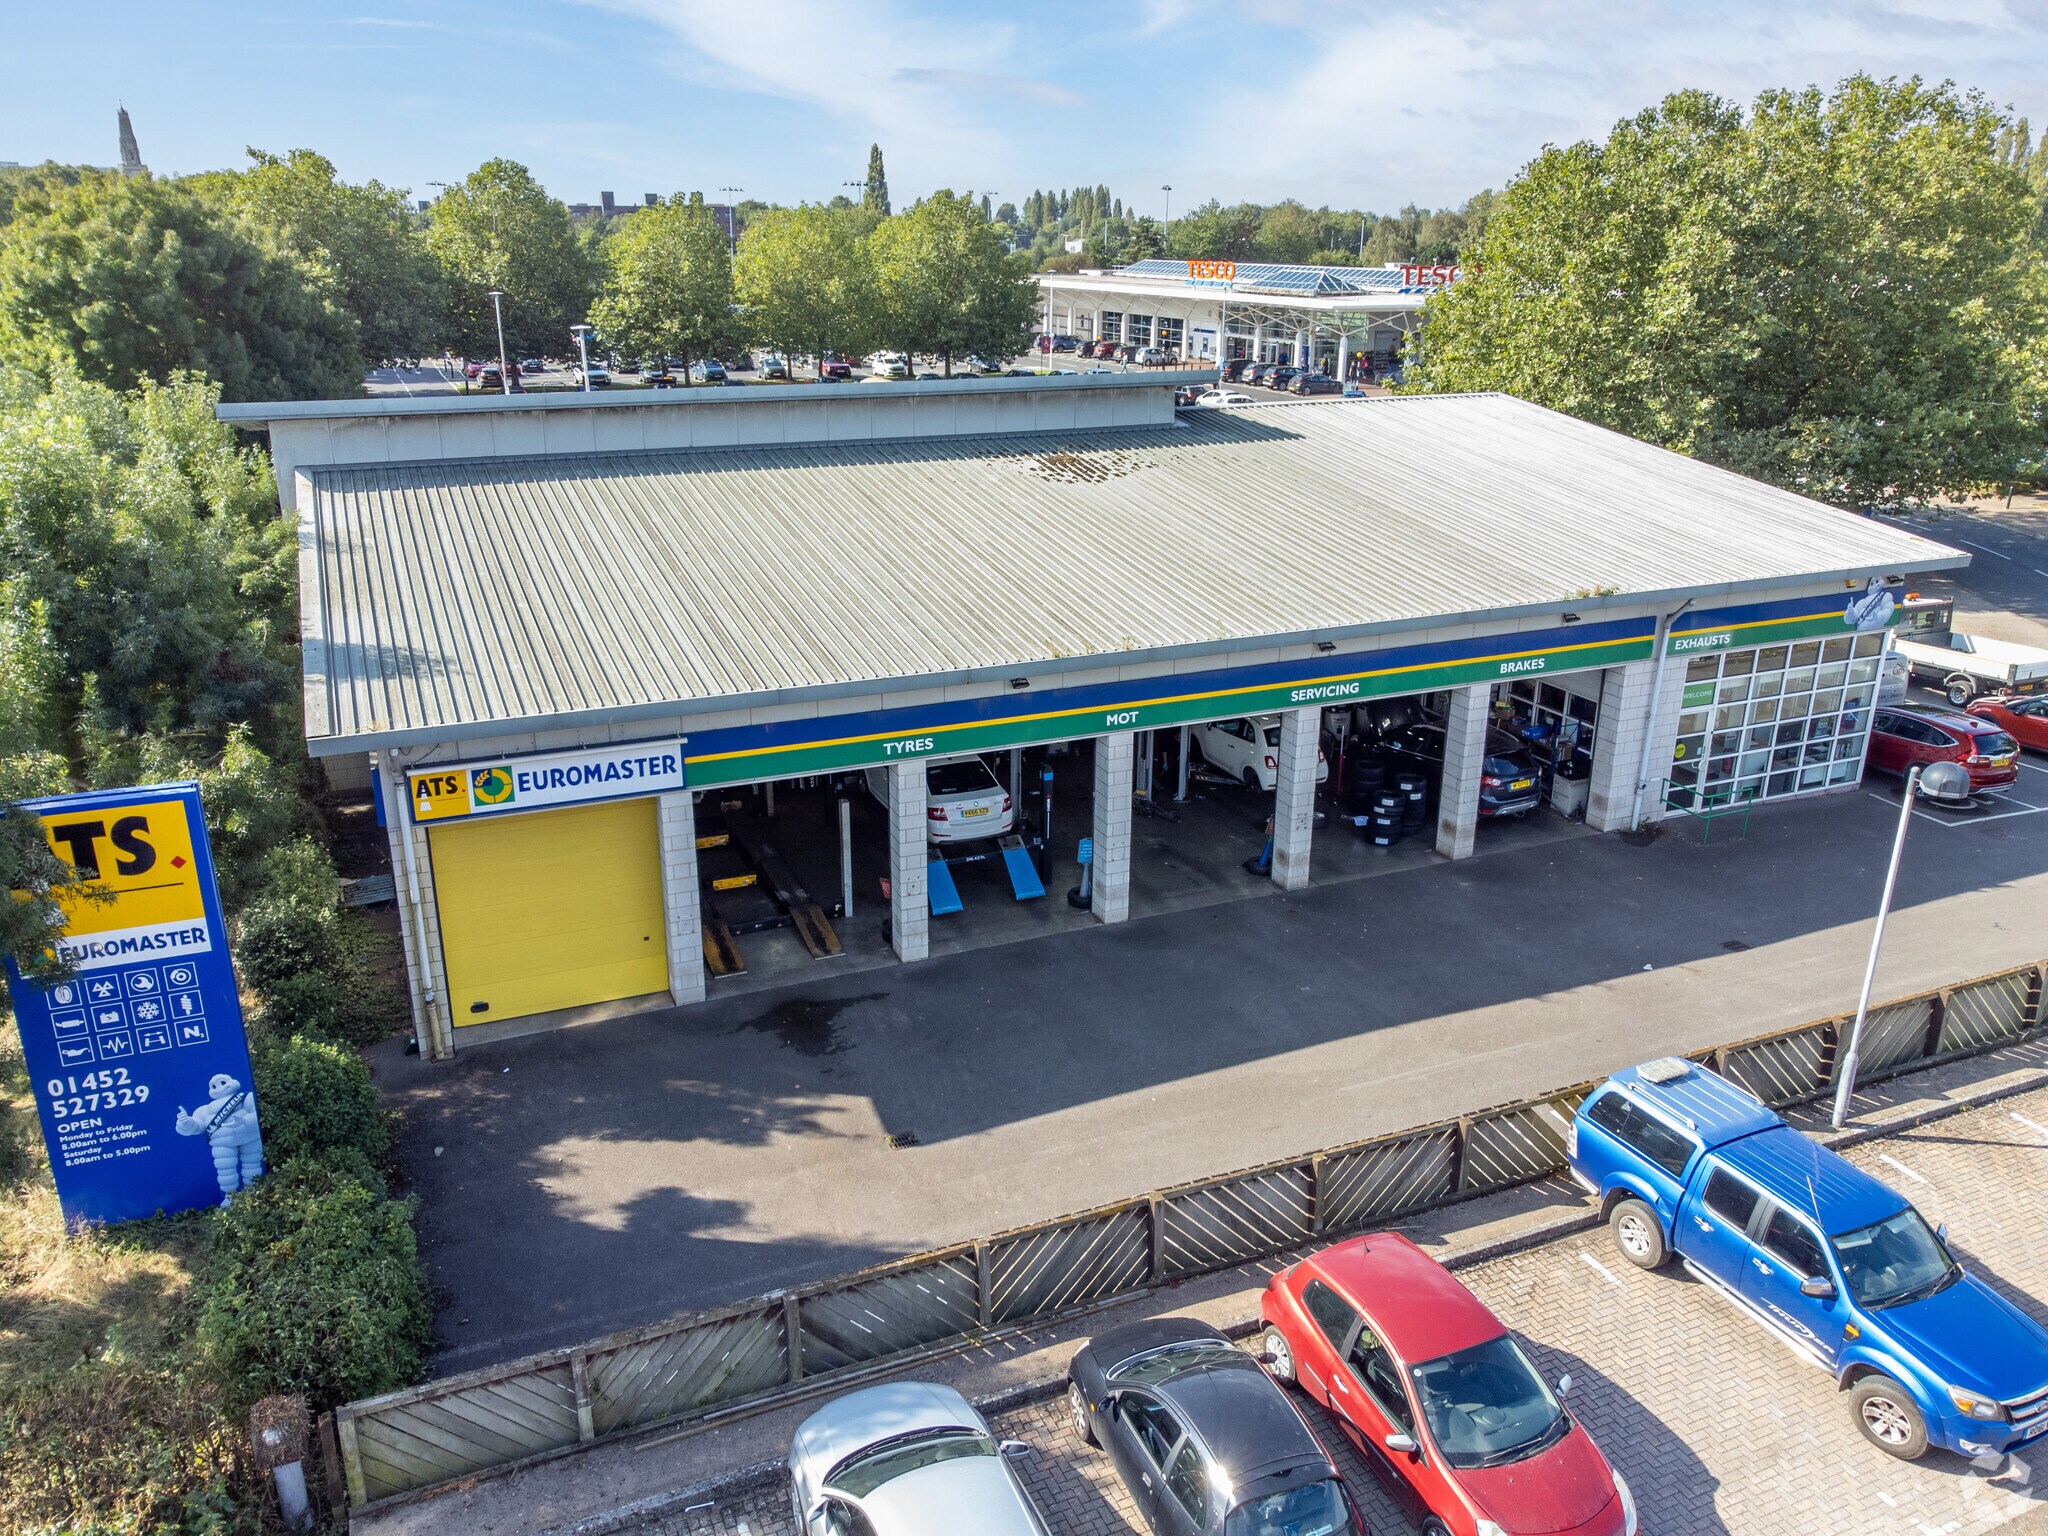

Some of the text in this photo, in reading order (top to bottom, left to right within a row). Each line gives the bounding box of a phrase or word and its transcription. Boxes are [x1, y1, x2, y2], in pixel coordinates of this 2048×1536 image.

[1186, 259, 1236, 280] TESCO
[1674, 634, 1731, 650] EXHAUSTS
[1499, 658, 1545, 674] BRAKES
[1290, 682, 1360, 702] SERVICING
[1683, 689, 1713, 699] WELCOME
[1106, 711, 1139, 726] MOT
[883, 737, 934, 755] TYRES
[416, 754, 678, 799] ATS EUROMASTER
[60, 927, 207, 962] EUROMASTER
[47, 1067, 131, 1097] 01452
[52, 1085, 150, 1118] 527329
[57, 1117, 103, 1133] OPEN
[59, 1124, 134, 1143] Monday to Friday
[61, 1129, 147, 1151] 8.00am to 6.00pm
[63, 1147, 102, 1159] Saturday
[65, 1155, 101, 1167] 8.00am
[115, 1145, 151, 1157] 5.00pm
